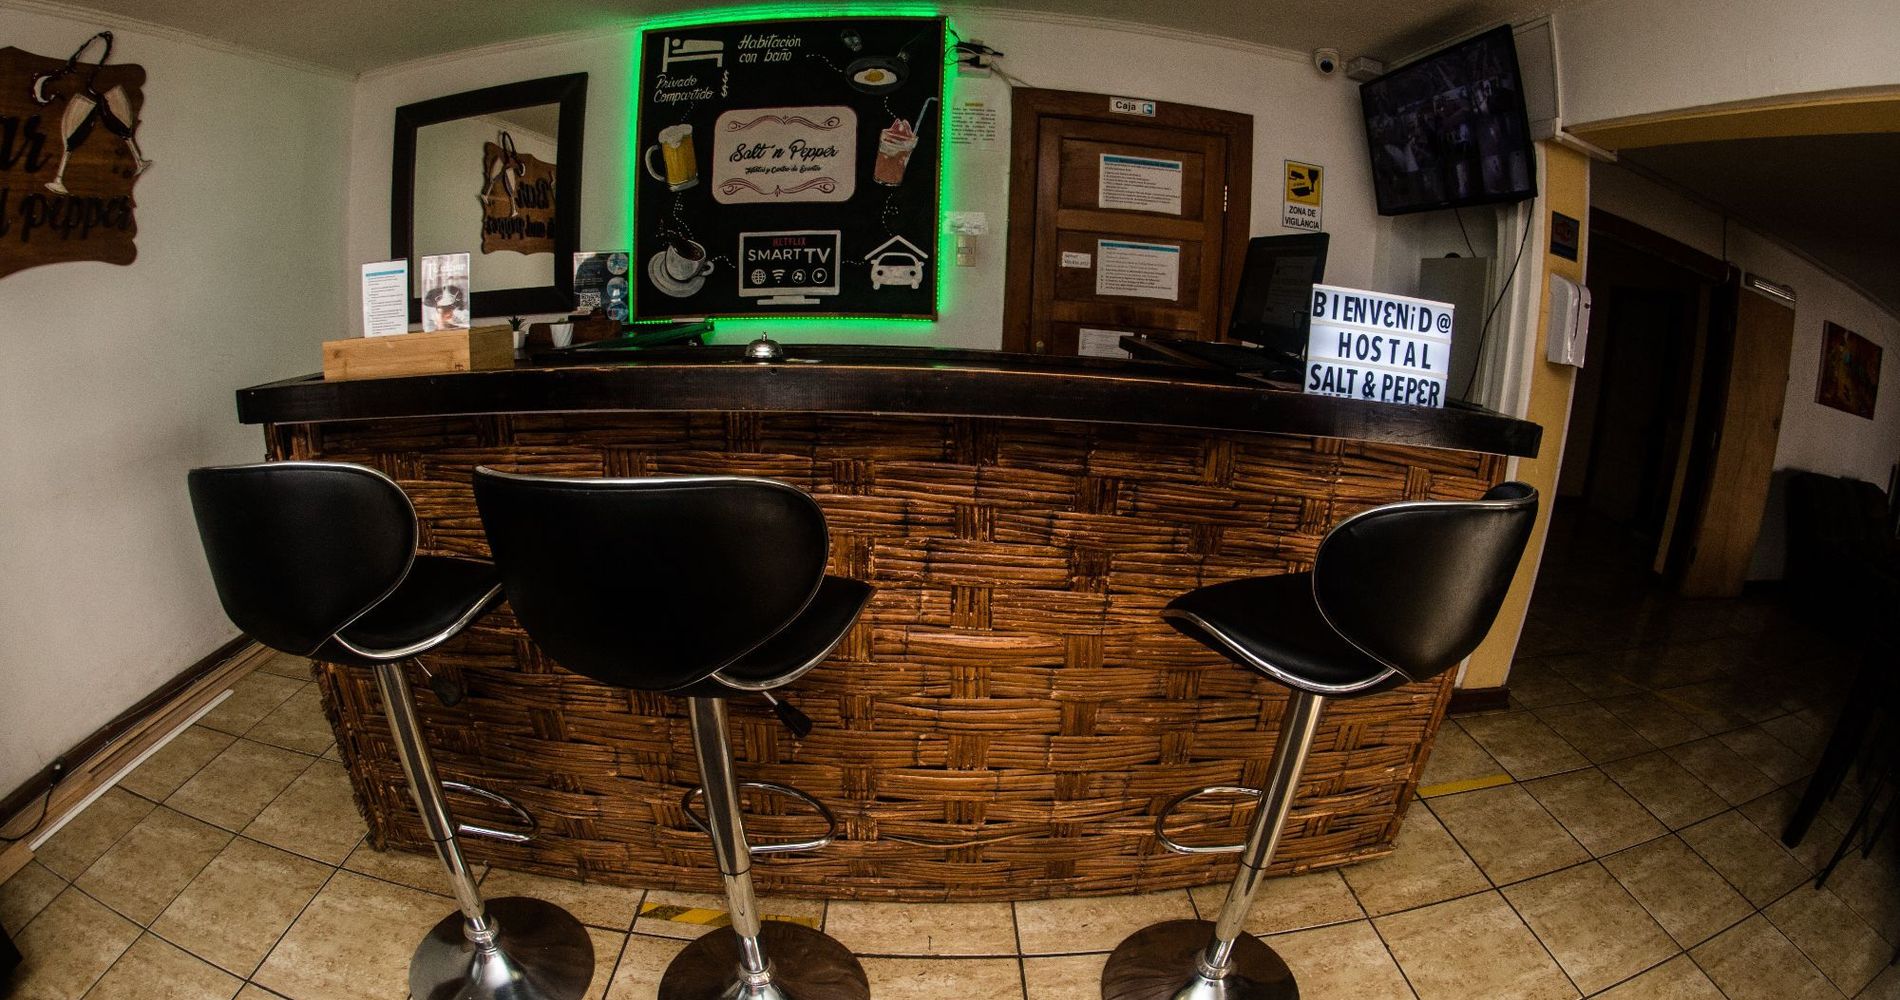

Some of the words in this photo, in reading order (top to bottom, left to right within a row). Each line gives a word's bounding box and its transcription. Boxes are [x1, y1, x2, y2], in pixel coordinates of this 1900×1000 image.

[737, 34, 802, 49] Habitación
[738, 51, 758, 63] con
[764, 48, 792, 63] baño
[655, 73, 698, 89] Privado
[653, 88, 714, 106] Compartido
[1115, 101, 1136, 111] Caja
[729, 143, 768, 163] Salt
[788, 139, 839, 161] Pepper
[1288, 205, 1306, 216] ZONA
[1307, 209, 1317, 218] DE
[772, 237, 807, 247] NETFLIX
[747, 248, 802, 261] SMART
[803, 247, 831, 264] TV
[1338, 331, 1432, 370] HOSTAL
[1308, 364, 1358, 393] SALT
[1362, 371, 1376, 398] &
[1381, 373, 1440, 407] PEPER
